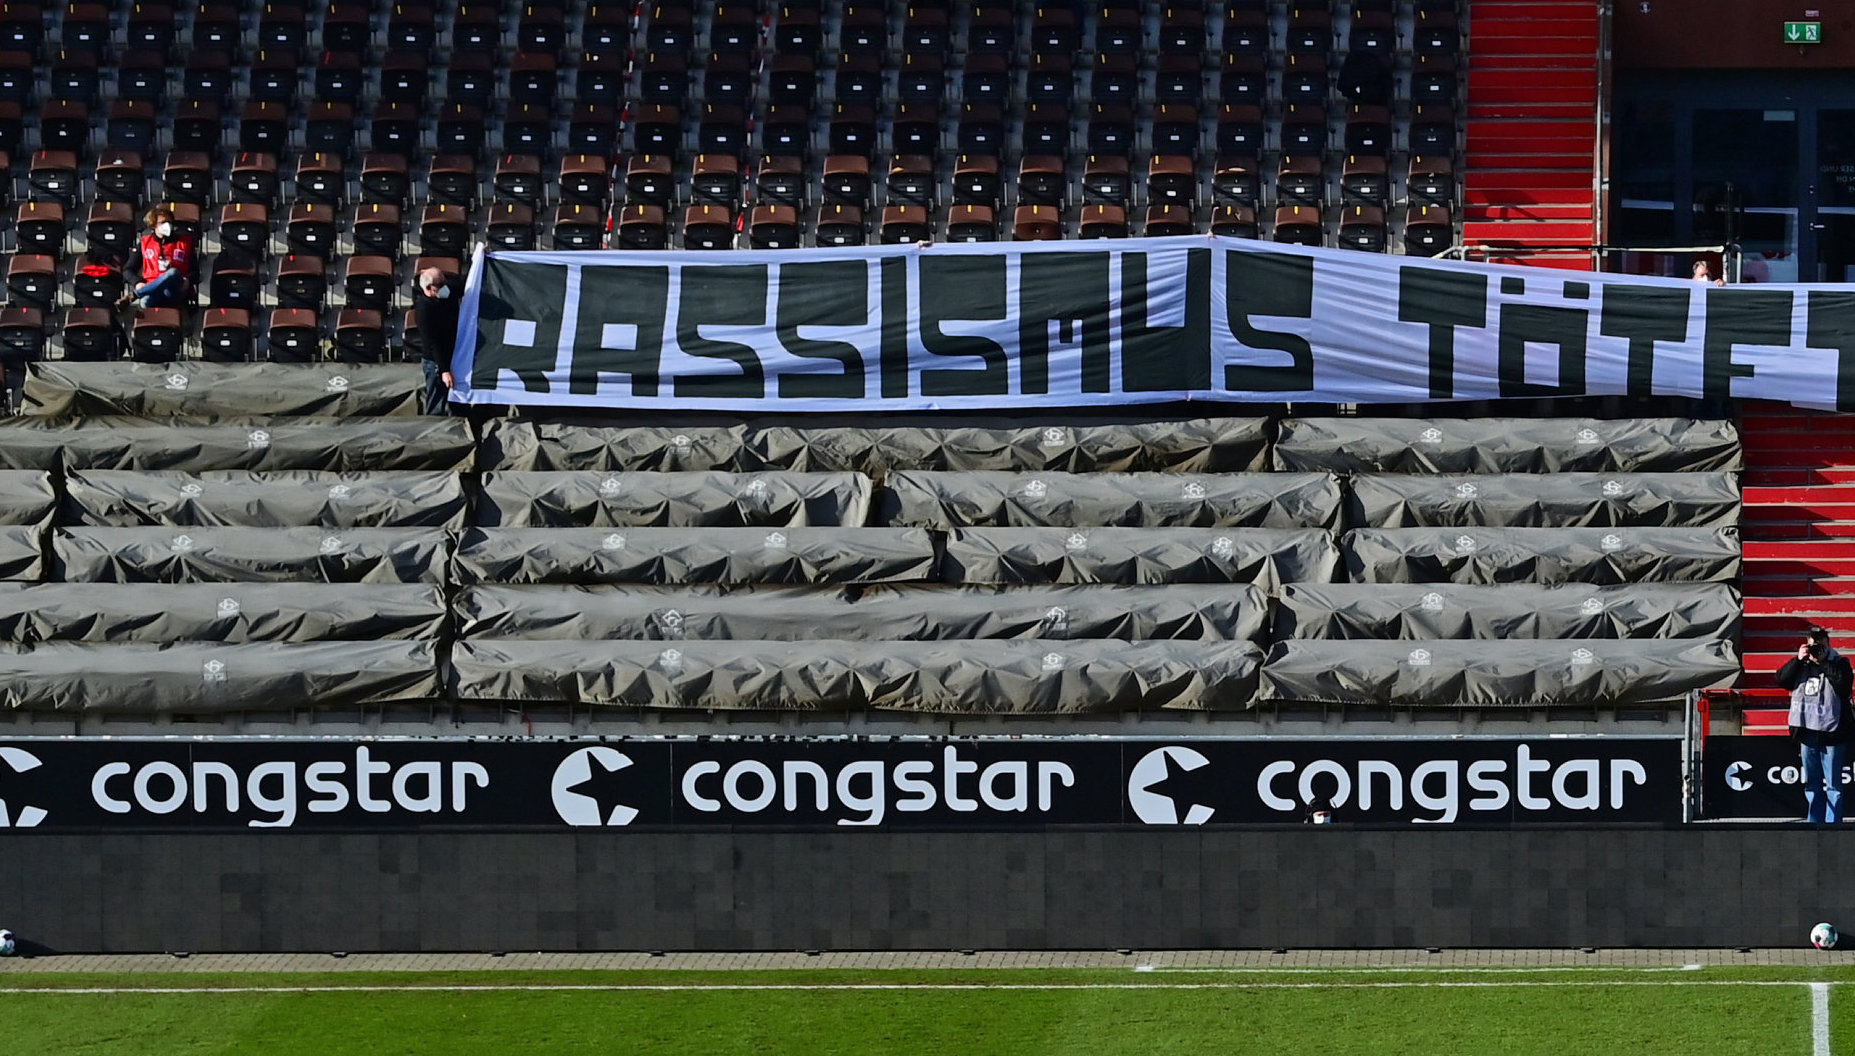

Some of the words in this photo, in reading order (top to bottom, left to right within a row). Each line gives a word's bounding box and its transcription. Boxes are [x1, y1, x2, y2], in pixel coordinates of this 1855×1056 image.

[470, 248, 1314, 397] RASSISMUS
[92, 746, 489, 828] congstar
[682, 746, 1075, 826] congstar
[1257, 744, 1647, 823] congstar
